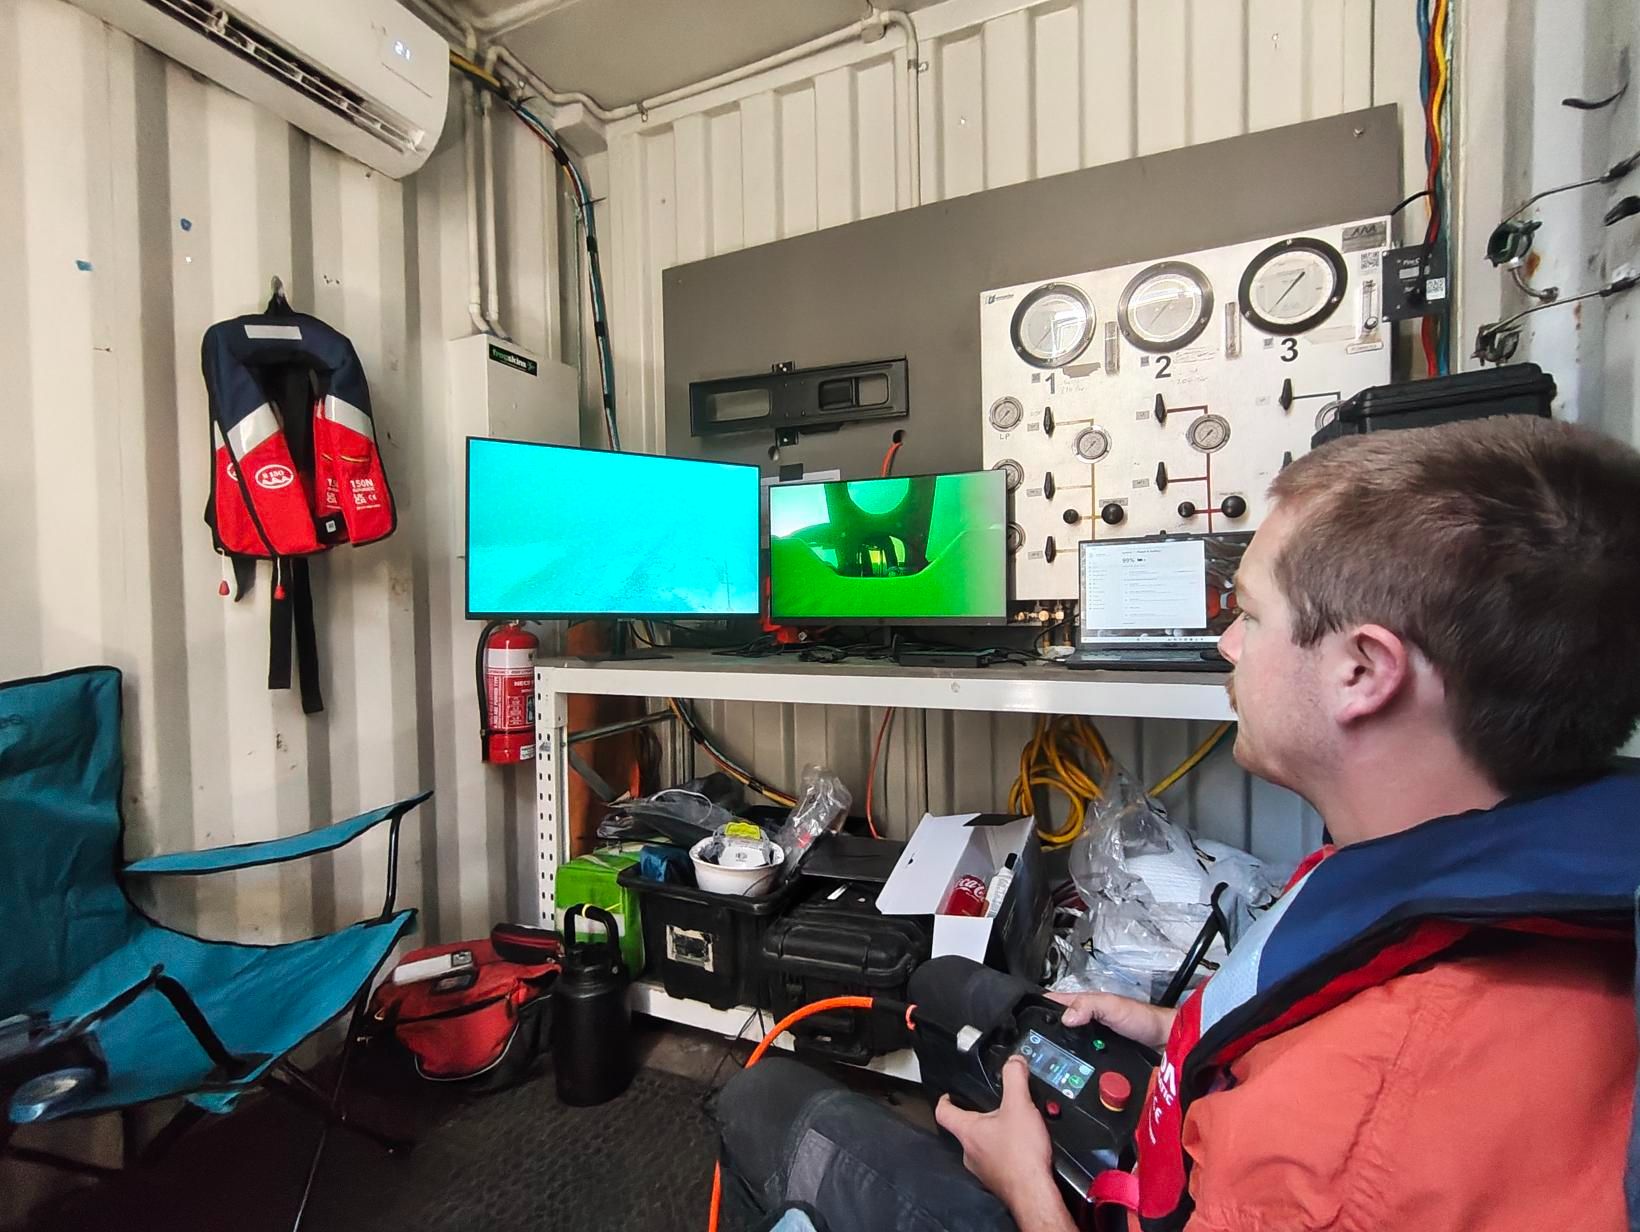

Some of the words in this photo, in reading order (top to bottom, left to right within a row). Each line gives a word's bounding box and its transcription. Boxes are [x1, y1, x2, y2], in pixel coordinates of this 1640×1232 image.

[1280, 337, 1299, 362] 3
[1154, 355, 1172, 379] 2
[1045, 372, 1055, 395] 1
[350, 479, 373, 488] 150N
